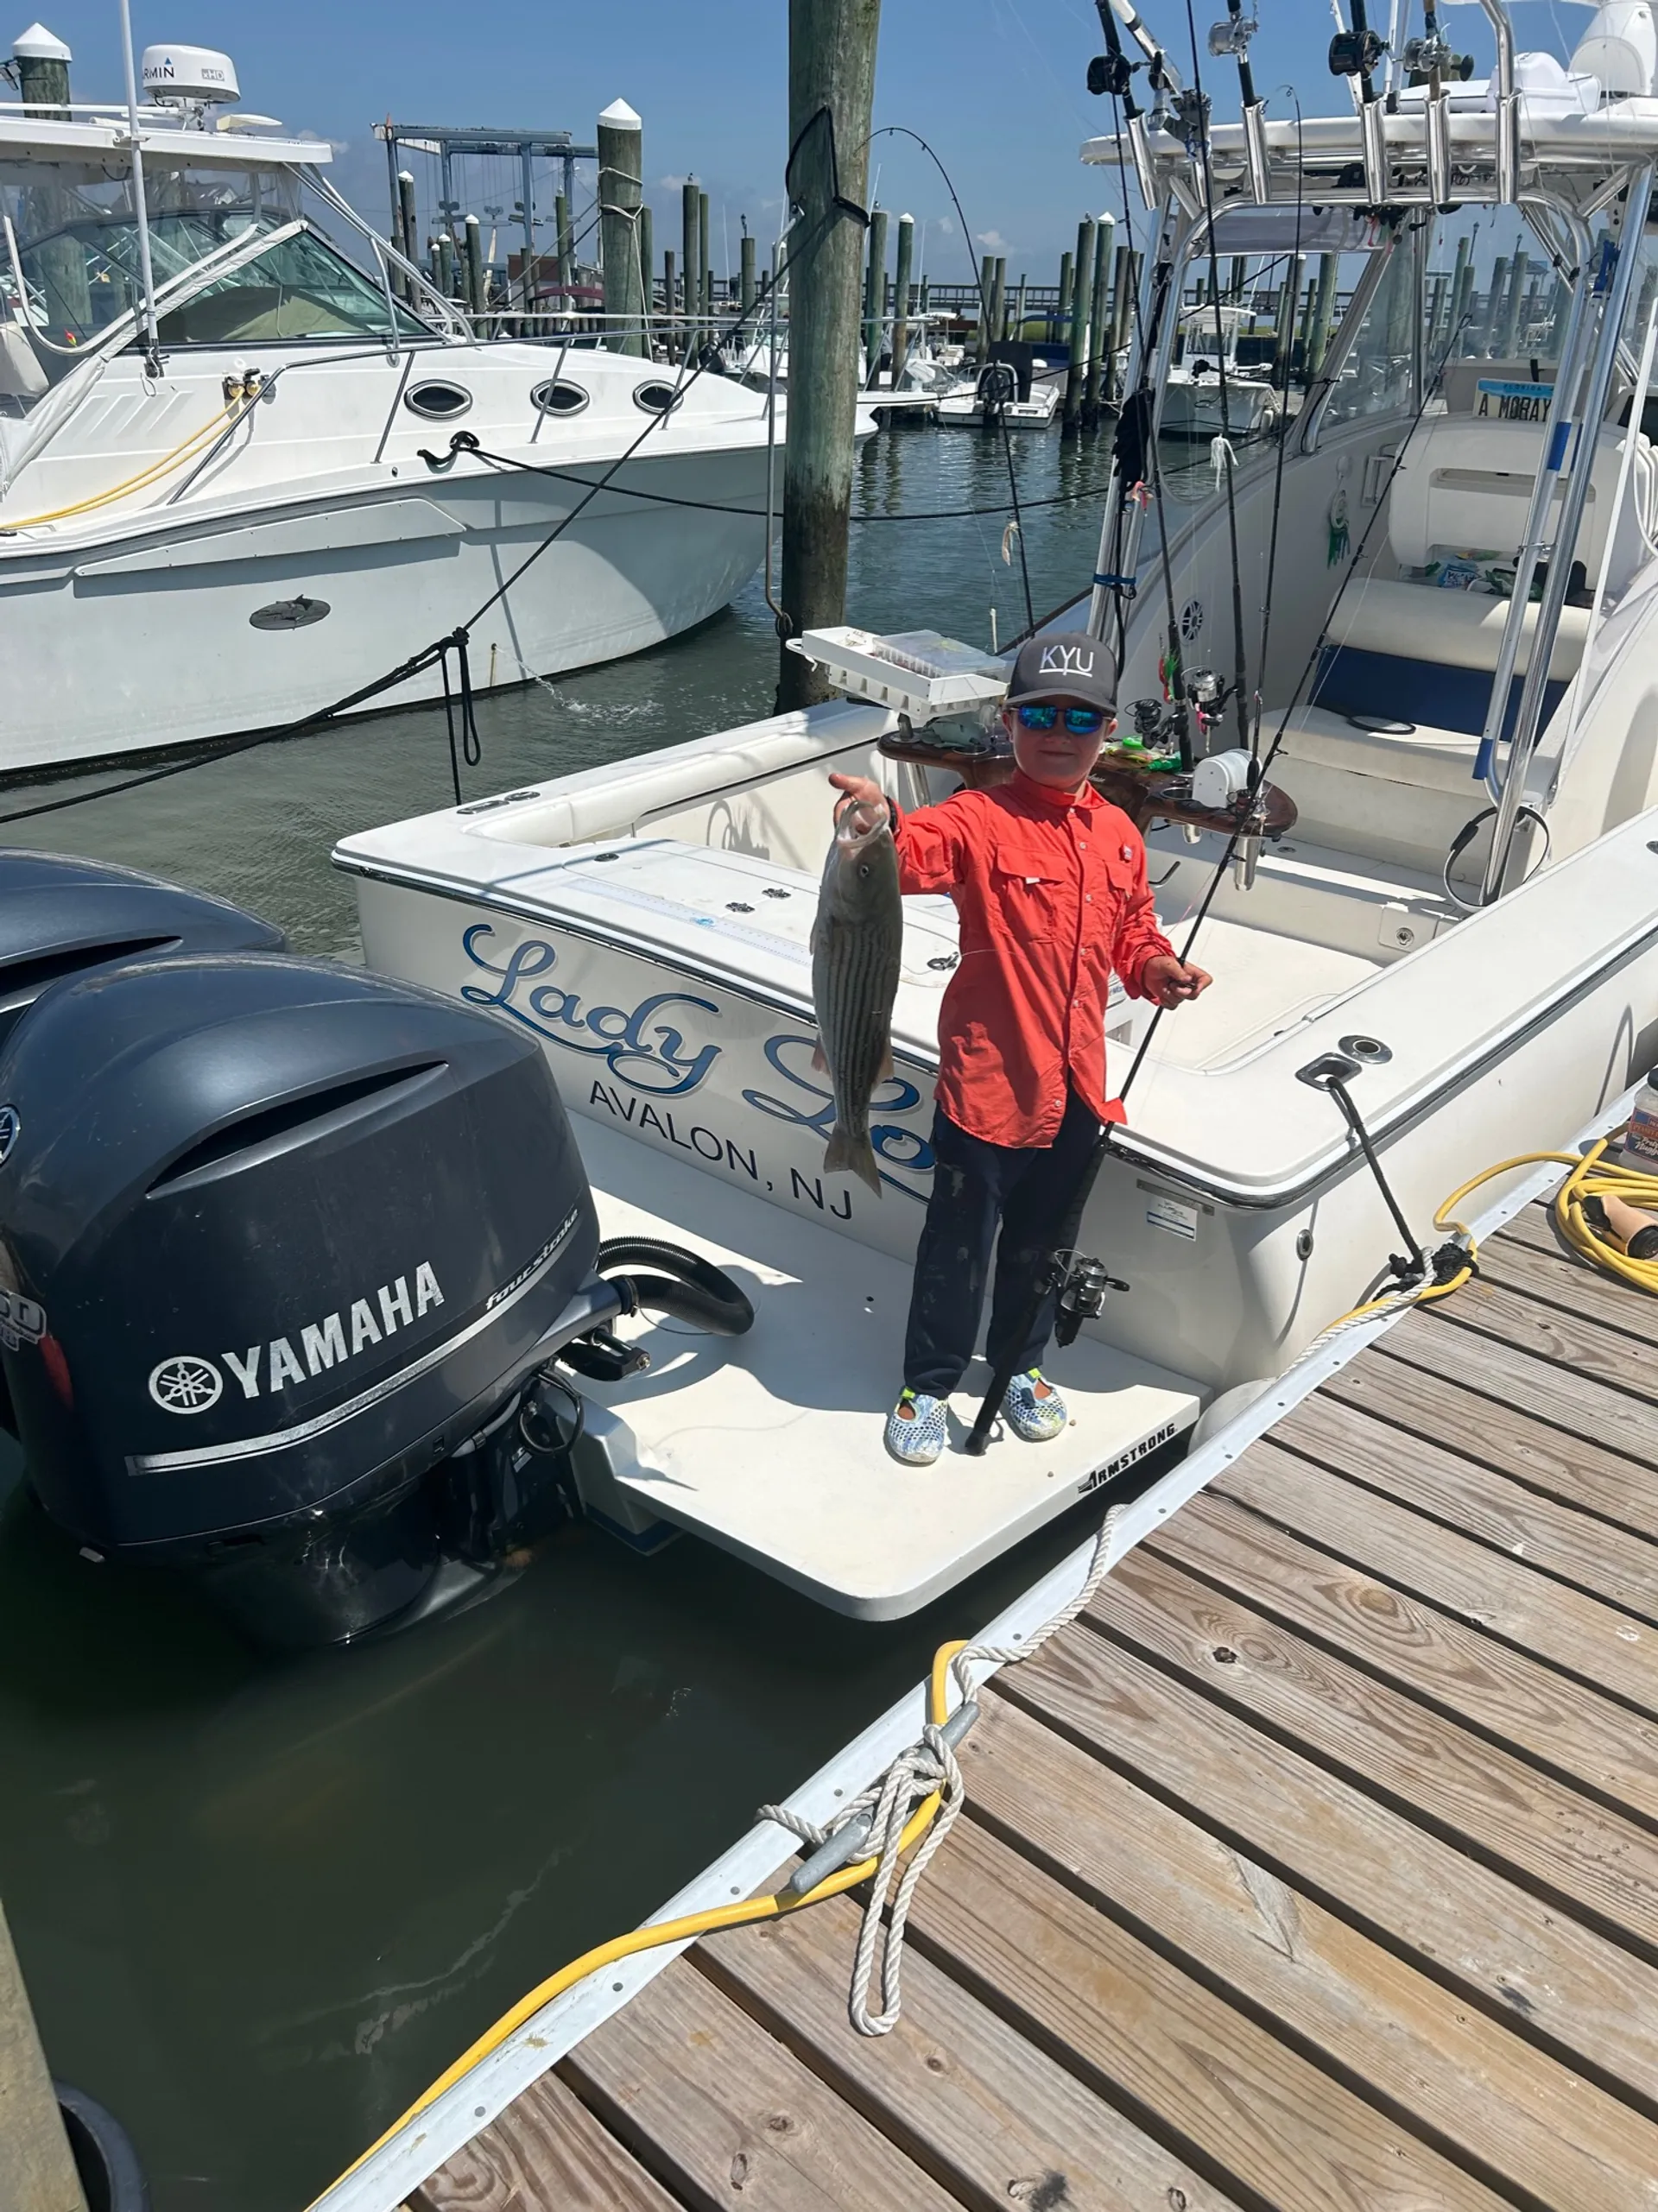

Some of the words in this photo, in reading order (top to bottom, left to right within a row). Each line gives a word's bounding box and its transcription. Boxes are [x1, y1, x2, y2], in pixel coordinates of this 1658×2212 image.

[142, 67, 174, 79] RMIN
[203, 70, 224, 80] xHD
[1478, 394, 1488, 416] A
[1498, 395, 1552, 422] MORAY
[1039, 645, 1094, 676] KYU
[460, 924, 722, 1095] Lady
[590, 1080, 773, 1191] AVALON,
[790, 1167, 852, 1220] NJ
[221, 1261, 445, 1399] YAMAHA
[1077, 1423, 1175, 1494] ARMSTRONG
